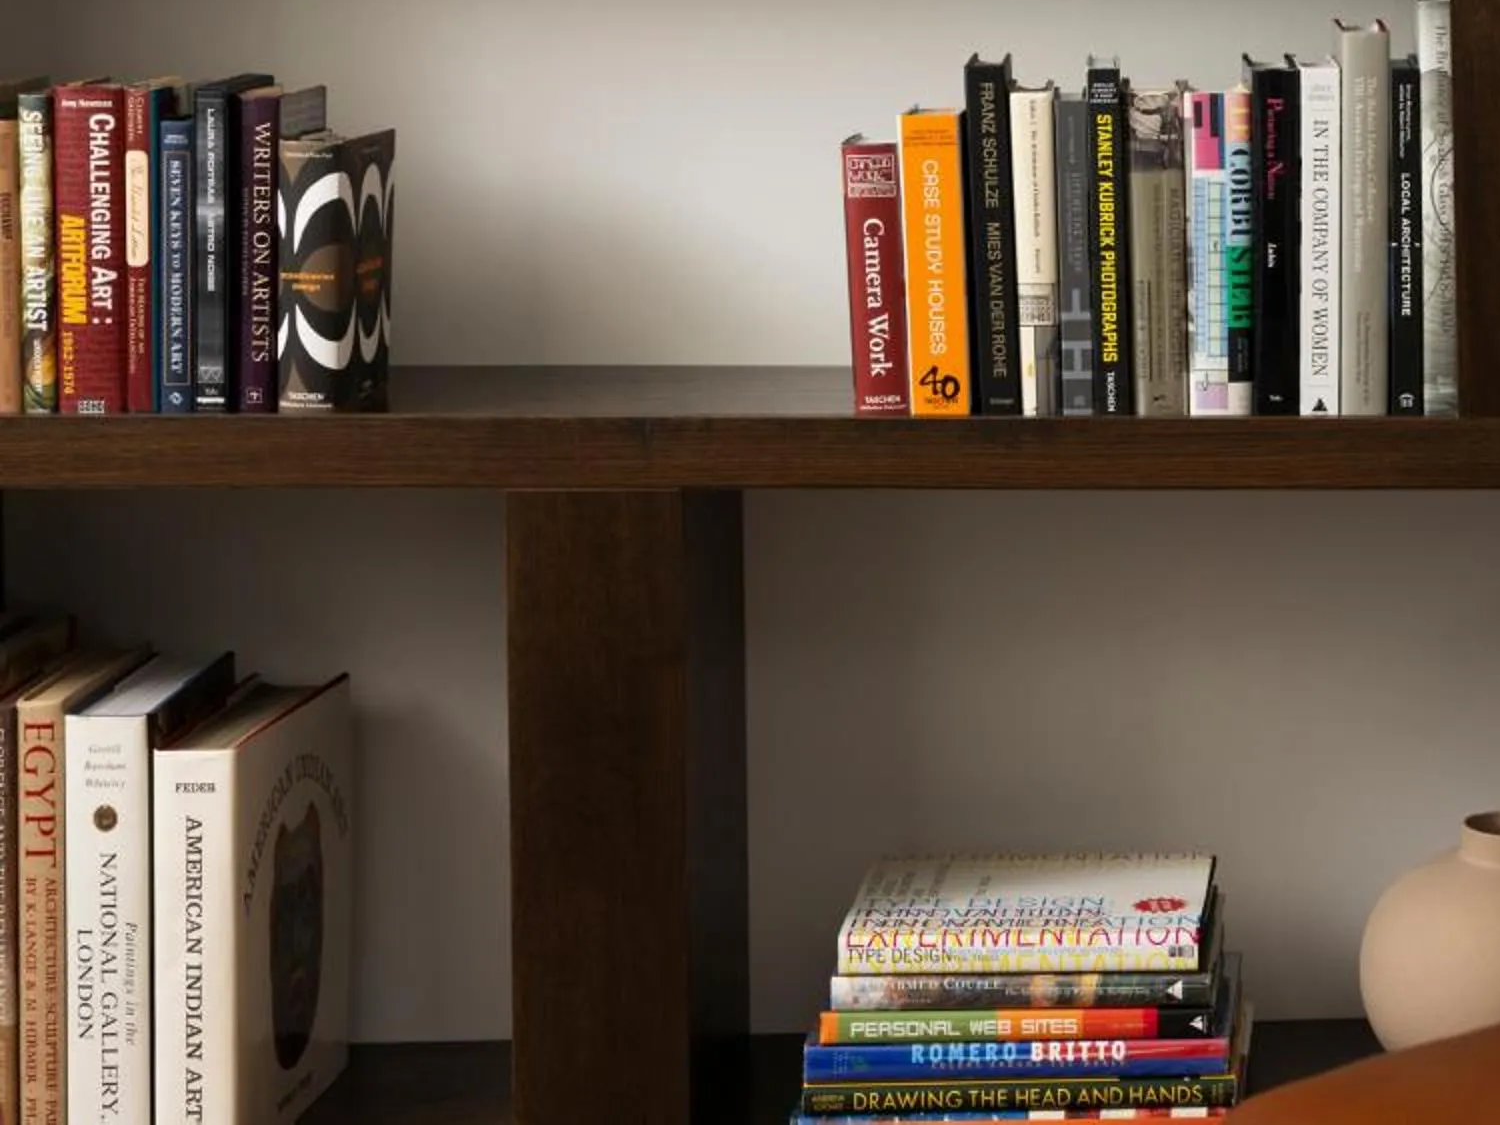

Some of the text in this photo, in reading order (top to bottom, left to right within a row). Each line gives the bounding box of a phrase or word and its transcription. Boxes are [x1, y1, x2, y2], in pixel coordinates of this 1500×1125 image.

[21, 109, 44, 178] SEEING
[207, 108, 215, 149] LAURA
[25, 186, 45, 232] LIKE
[26, 238, 46, 258] AN
[89, 114, 117, 310] CHALLENGING ART
[169, 160, 184, 373] SEVEN KEYS MODERN ART
[251, 122, 271, 363] WRITERS ON ARTISTS
[922, 159, 947, 356] CASE STUDY HOUSES
[980, 82, 1007, 378] FRANZ SCHULZE MIES VAN DER ROHE
[1096, 114, 1118, 412] STANLEY KUBRICK PHOTOGRAPHS TASCHEN
[1311, 120, 1330, 377] IN THE COMPANY OF WOMEN
[1401, 173, 1411, 317] LOCAL ARCHITECTURE
[26, 266, 48, 331] ARTIST
[61, 214, 87, 324] ARTFORUM
[207, 255, 216, 292] NOISE
[863, 218, 892, 377] Camera Work
[175, 783, 216, 793] FEDER
[24, 720, 59, 1091] EGYPT ARCHITECTURE SCULPTURE
[99, 853, 118, 984] NATIONAL
[846, 926, 1200, 948] EXPERIMENTATION
[849, 948, 953, 963] TYPE DESIGN
[25, 877, 39, 1085] BY LANGE & HIRMER
[78, 929, 94, 1041] LONDON
[124, 922, 139, 1046] Paintings in the
[184, 815, 204, 1123] AMERICAN INDIAN ART
[849, 1018, 1077, 1039] PERSONAL WEB SITES
[911, 1040, 1127, 1065] ROMERO BRITTO
[852, 1085, 1203, 1112] DRAWING THE HEAD AND HANDS
